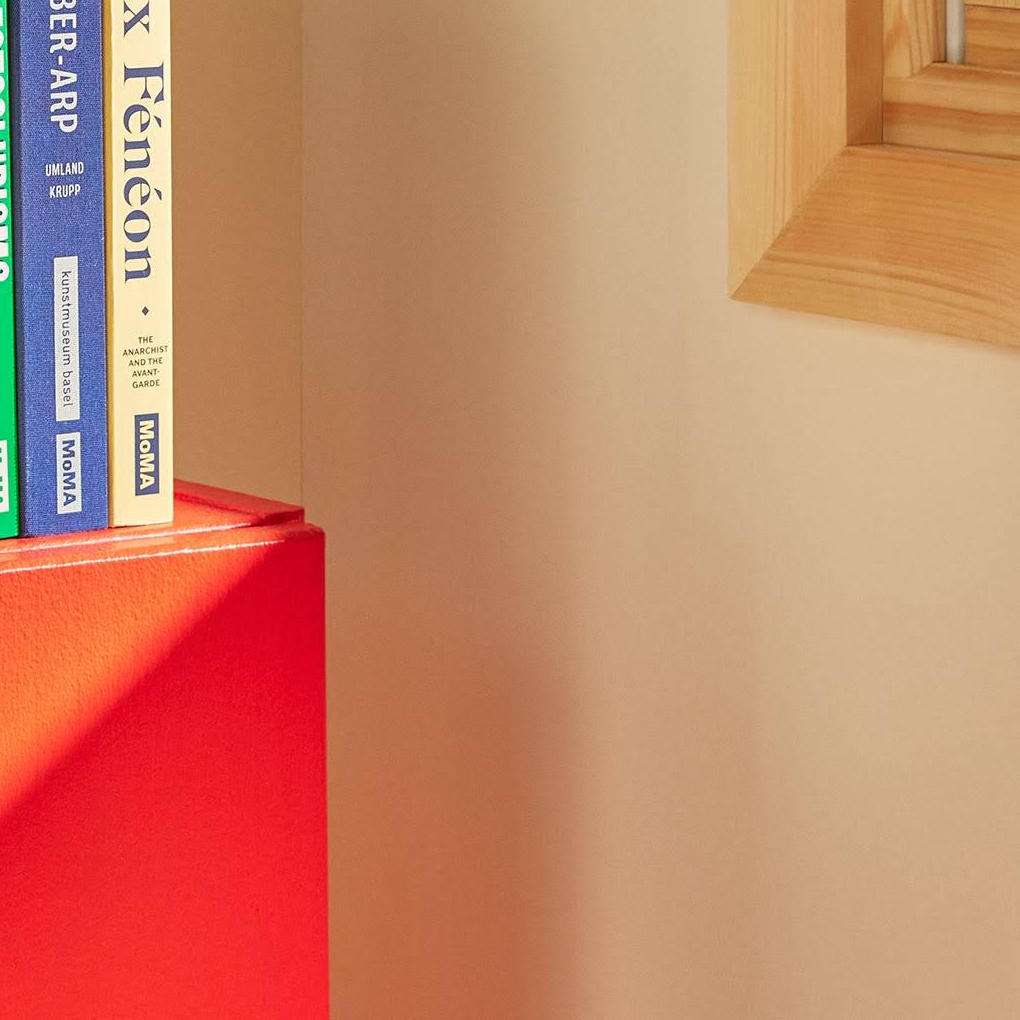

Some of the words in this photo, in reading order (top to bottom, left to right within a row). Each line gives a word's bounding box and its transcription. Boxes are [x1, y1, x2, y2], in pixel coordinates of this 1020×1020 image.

[45, 161, 85, 177] UMLAND
[123, 62, 165, 284] Fénéon
[49, 184, 81, 199] KRUPP
[61, 270, 72, 366] kunstmuseum
[138, 335, 154, 344] THE
[122, 345, 169, 357] ANARCHIST
[128, 358, 147, 367] AND
[148, 357, 163, 366] THE
[132, 369, 160, 378] AVANT-
[62, 370, 73, 408] basel
[132, 379, 161, 389] GARDE
[139, 419, 155, 490] MoMA
[62, 439, 77, 507] MoMA
